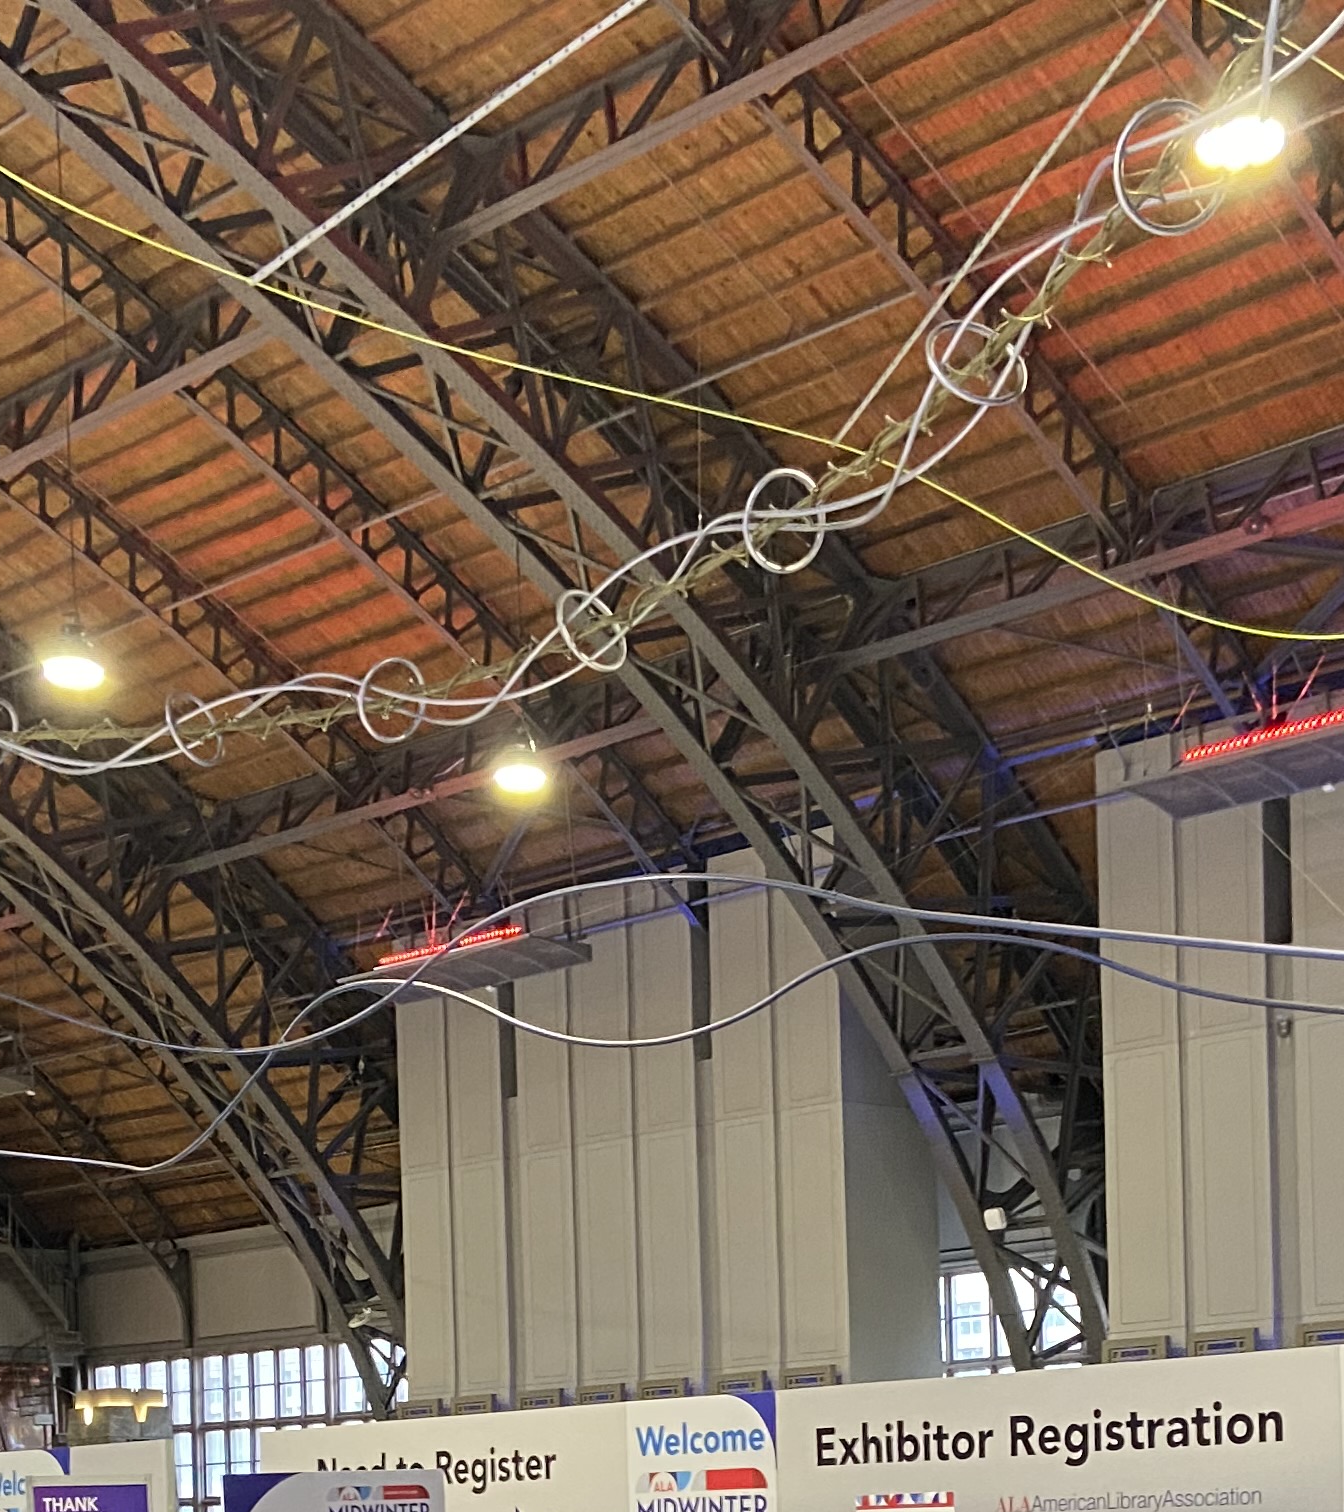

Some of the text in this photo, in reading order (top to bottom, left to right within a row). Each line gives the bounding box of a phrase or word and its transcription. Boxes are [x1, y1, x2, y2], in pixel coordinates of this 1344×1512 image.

[635, 1422, 765, 1457] Welcome
[815, 1401, 1285, 1467] Exhibitor Registration
[436, 1445, 558, 1494] Register
[654, 1481, 674, 1492] ALA
[42, 1496, 99, 1512] THANK
